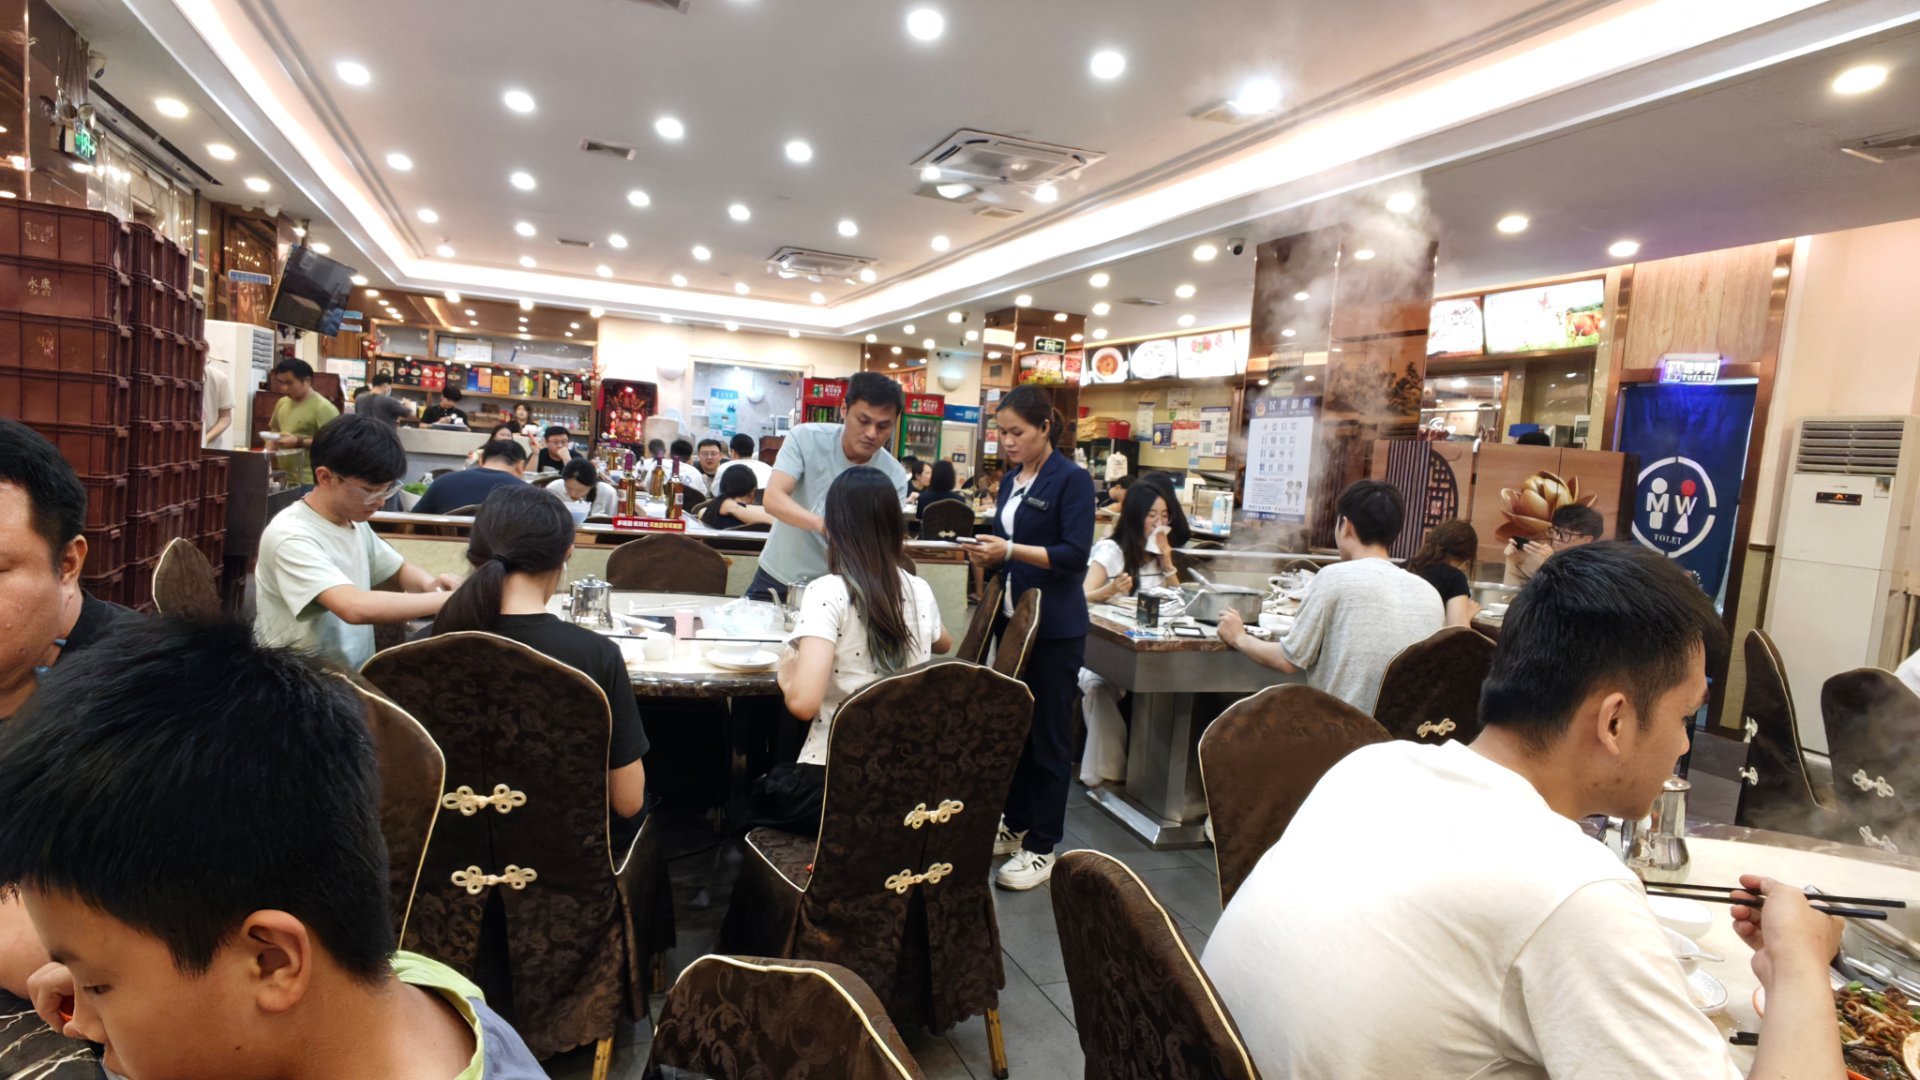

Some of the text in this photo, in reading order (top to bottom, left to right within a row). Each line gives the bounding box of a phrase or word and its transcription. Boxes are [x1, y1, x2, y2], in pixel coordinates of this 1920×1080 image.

[1682, 374, 1714, 382] TOILET
[1646, 492, 1698, 516] M W
